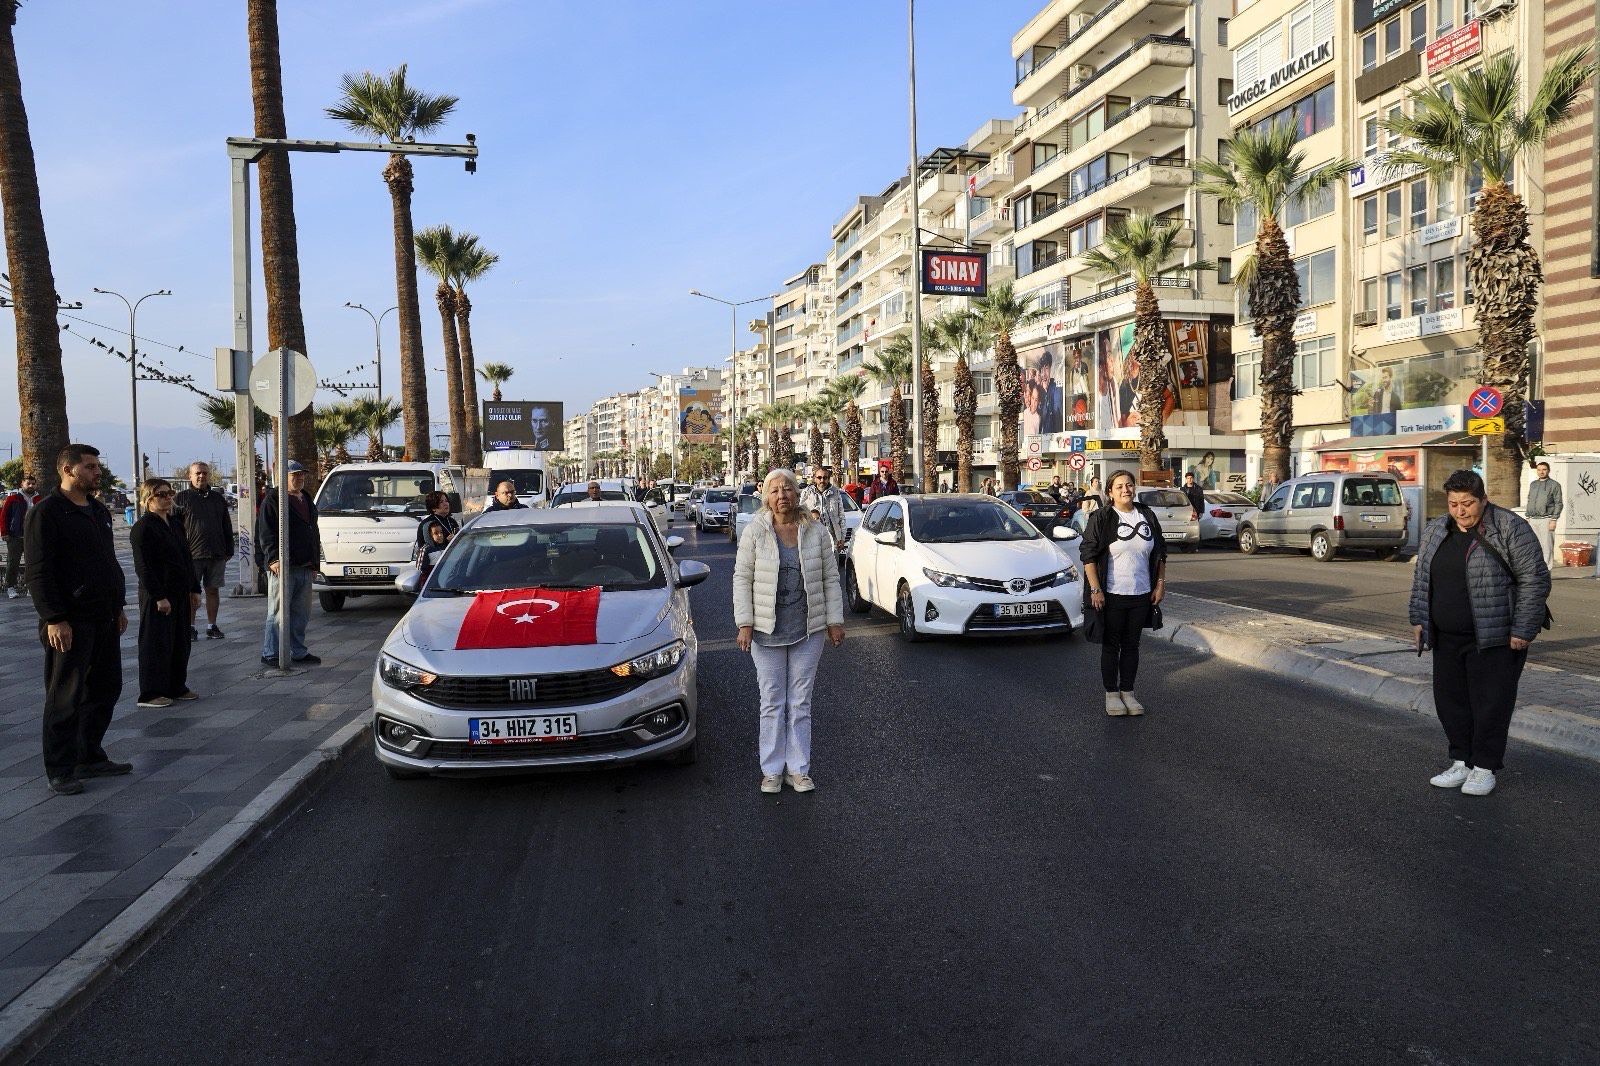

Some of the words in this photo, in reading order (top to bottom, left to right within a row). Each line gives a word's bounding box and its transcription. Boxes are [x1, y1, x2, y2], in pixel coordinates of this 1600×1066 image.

[1228, 79, 1267, 112] TOKGÖZ
[1269, 41, 1330, 90] AVUKATLIK
[930, 256, 979, 282] SINAV
[1400, 425, 1414, 433] Türk
[1416, 424, 1443, 432] Telekom
[1073, 437, 1082, 451] P
[348, 567, 356, 575] 34
[360, 567, 373, 575] FEU
[375, 567, 388, 575] 213
[1000, 605, 1011, 615] 35
[1027, 603, 1046, 614] 9991
[509, 679, 538, 701] FIAT
[480, 721, 500, 738] 34
[506, 719, 537, 737] HHZ
[543, 717, 572, 735] 315
